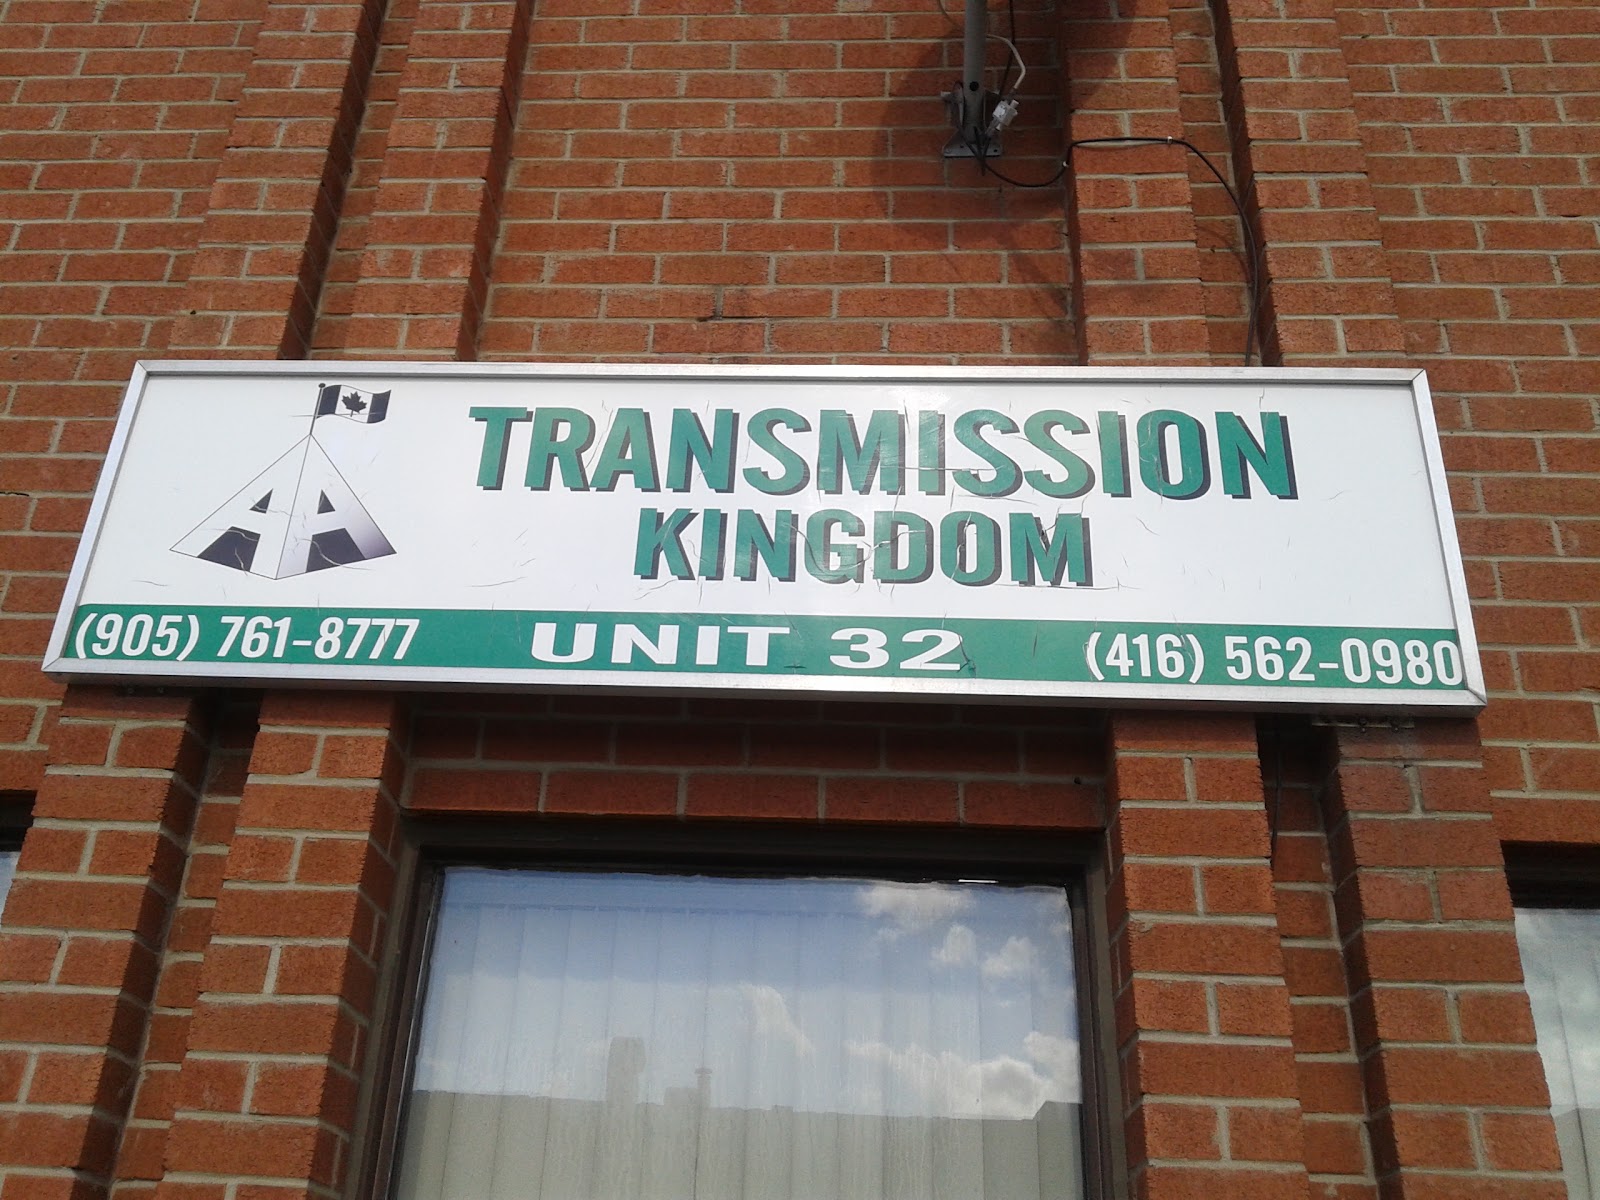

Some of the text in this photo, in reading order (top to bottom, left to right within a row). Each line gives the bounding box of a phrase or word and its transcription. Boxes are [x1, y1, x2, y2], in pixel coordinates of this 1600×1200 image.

[469, 406, 1298, 501] TRANSMISSION
[634, 507, 1093, 588] KINGDOM
[75, 611, 420, 662] (905) 761-8777
[531, 622, 963, 672] UNIT 32
[1086, 632, 1464, 687] (416) 562-0980
